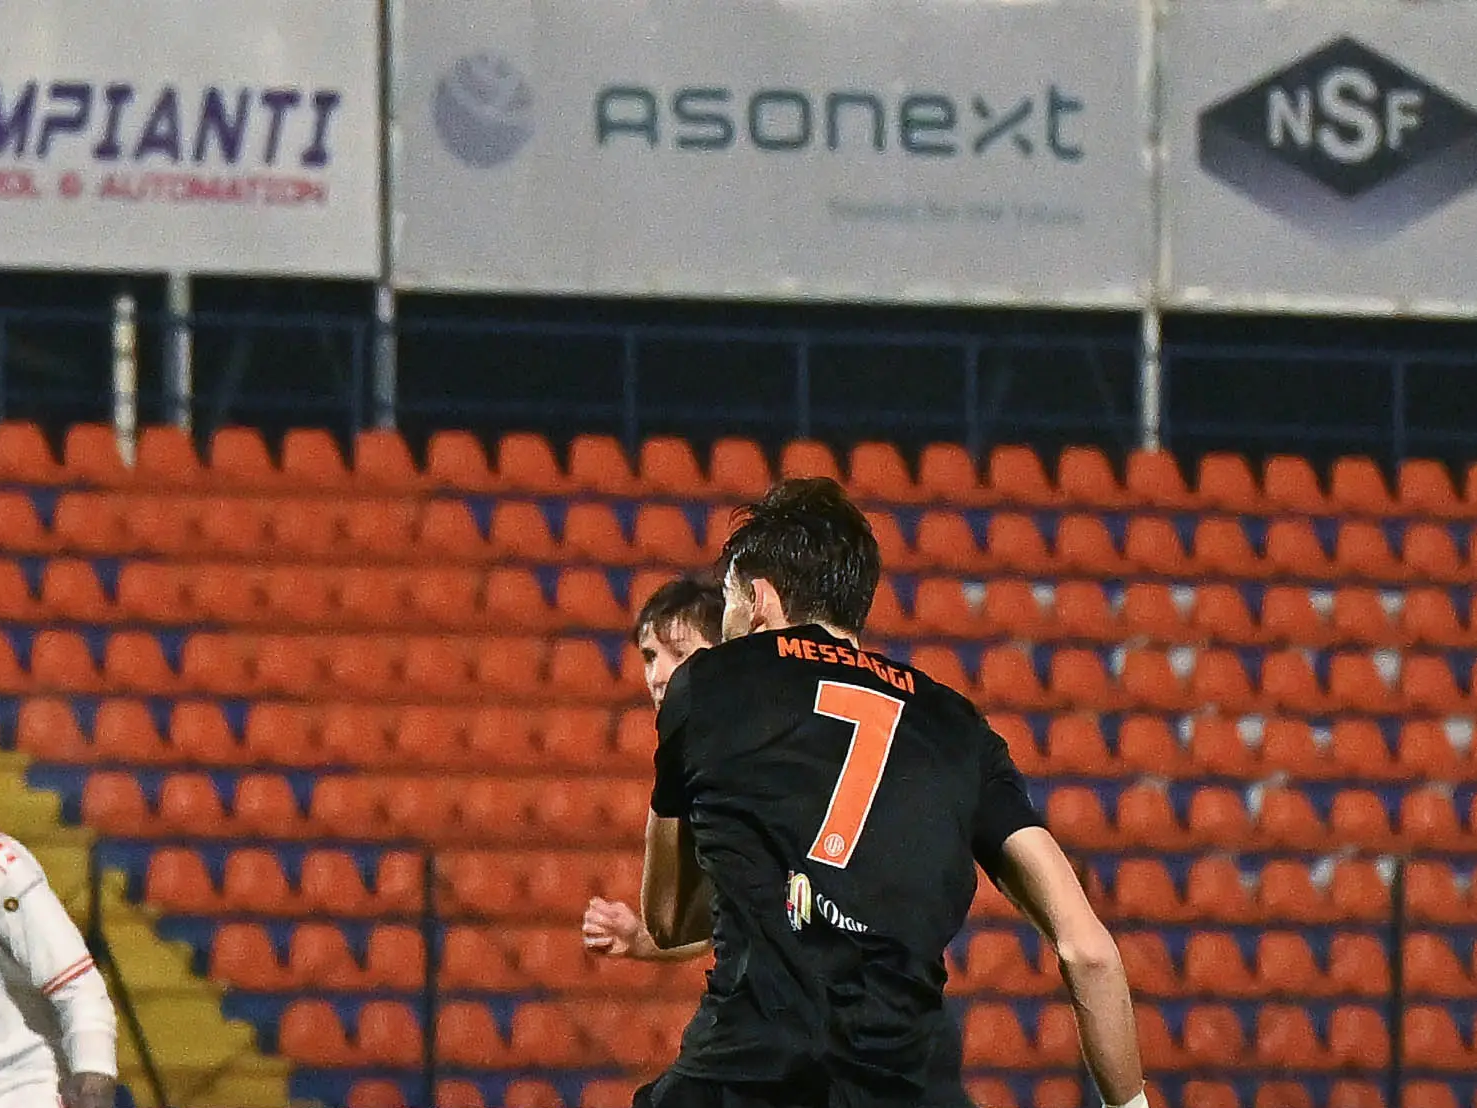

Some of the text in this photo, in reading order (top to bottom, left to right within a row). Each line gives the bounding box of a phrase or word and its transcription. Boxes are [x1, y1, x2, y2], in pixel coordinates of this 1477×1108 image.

[1266, 66, 1426, 164] NSF
[776, 635, 915, 694] MESSAGGI
[806, 679, 906, 869] 7
